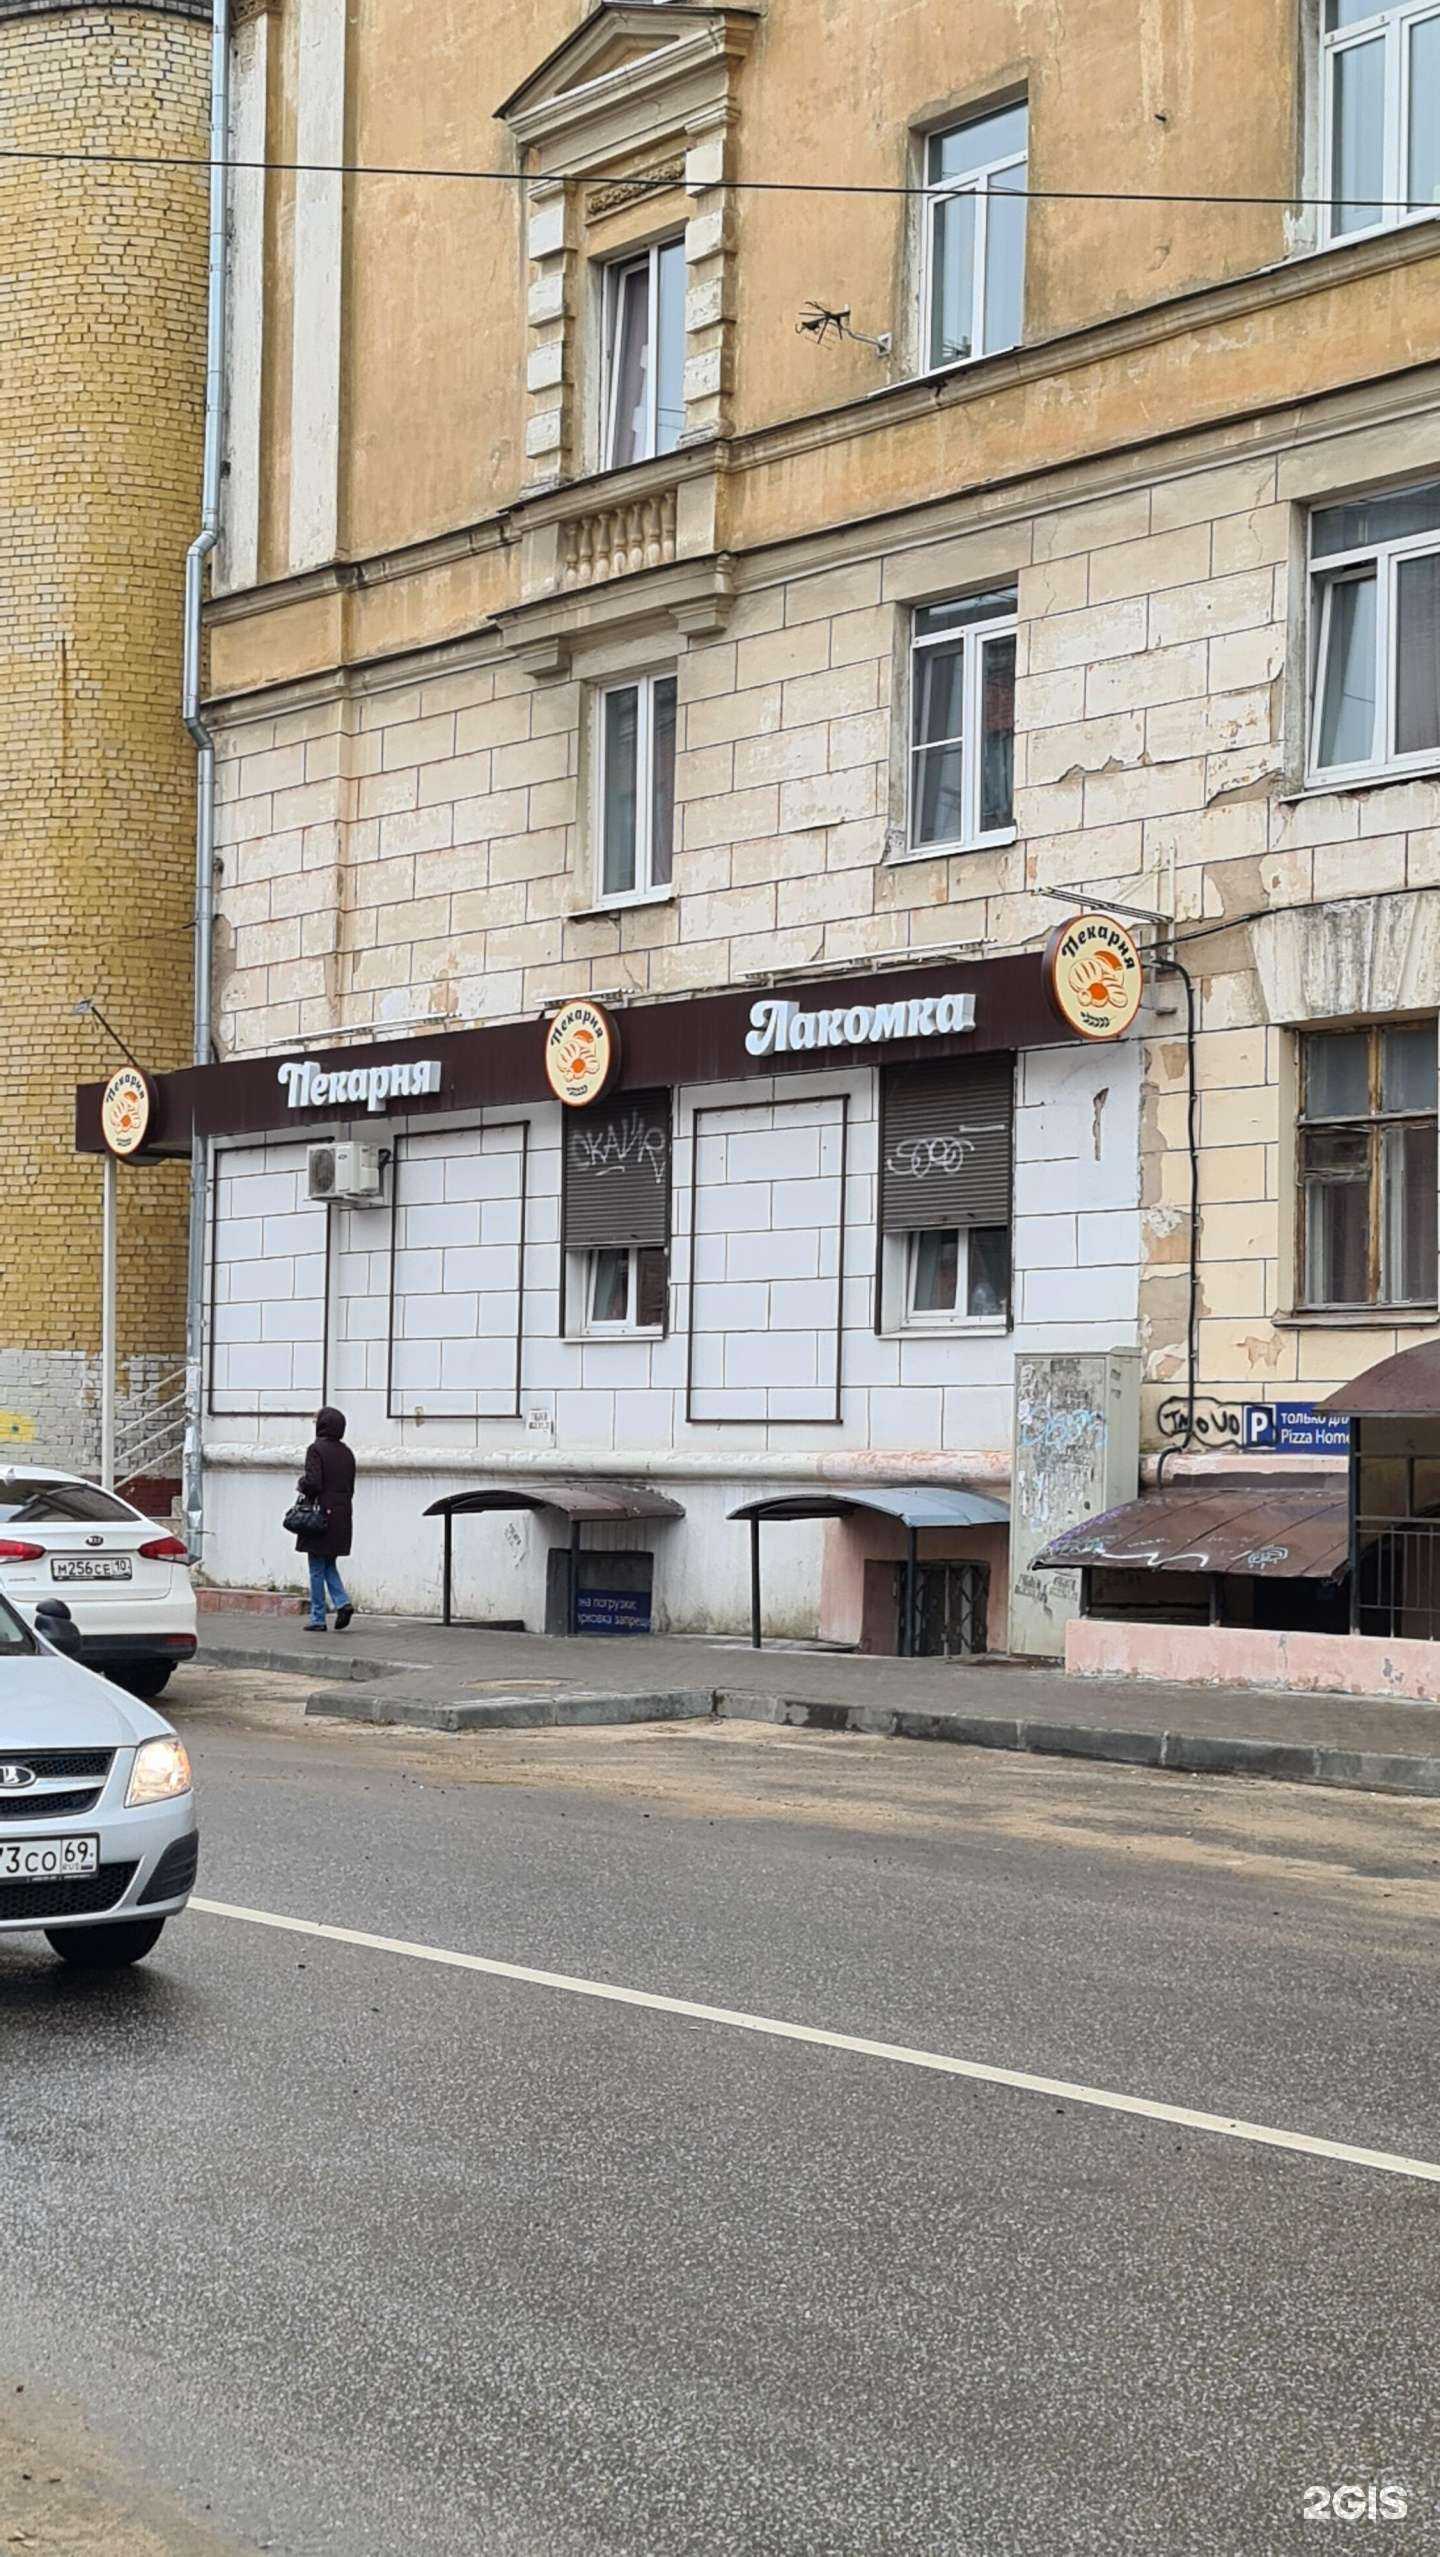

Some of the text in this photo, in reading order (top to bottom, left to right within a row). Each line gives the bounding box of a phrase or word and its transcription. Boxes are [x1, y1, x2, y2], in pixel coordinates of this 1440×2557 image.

[1061, 925, 1135, 969] Пекарня
[550, 1009, 603, 1047] Пекарня
[745, 993, 976, 1056] Лакомка
[277, 1060, 442, 1112] Пекарня
[1280, 1429, 1312, 1444] Pizza
[64, 1841, 88, 1863] 69
